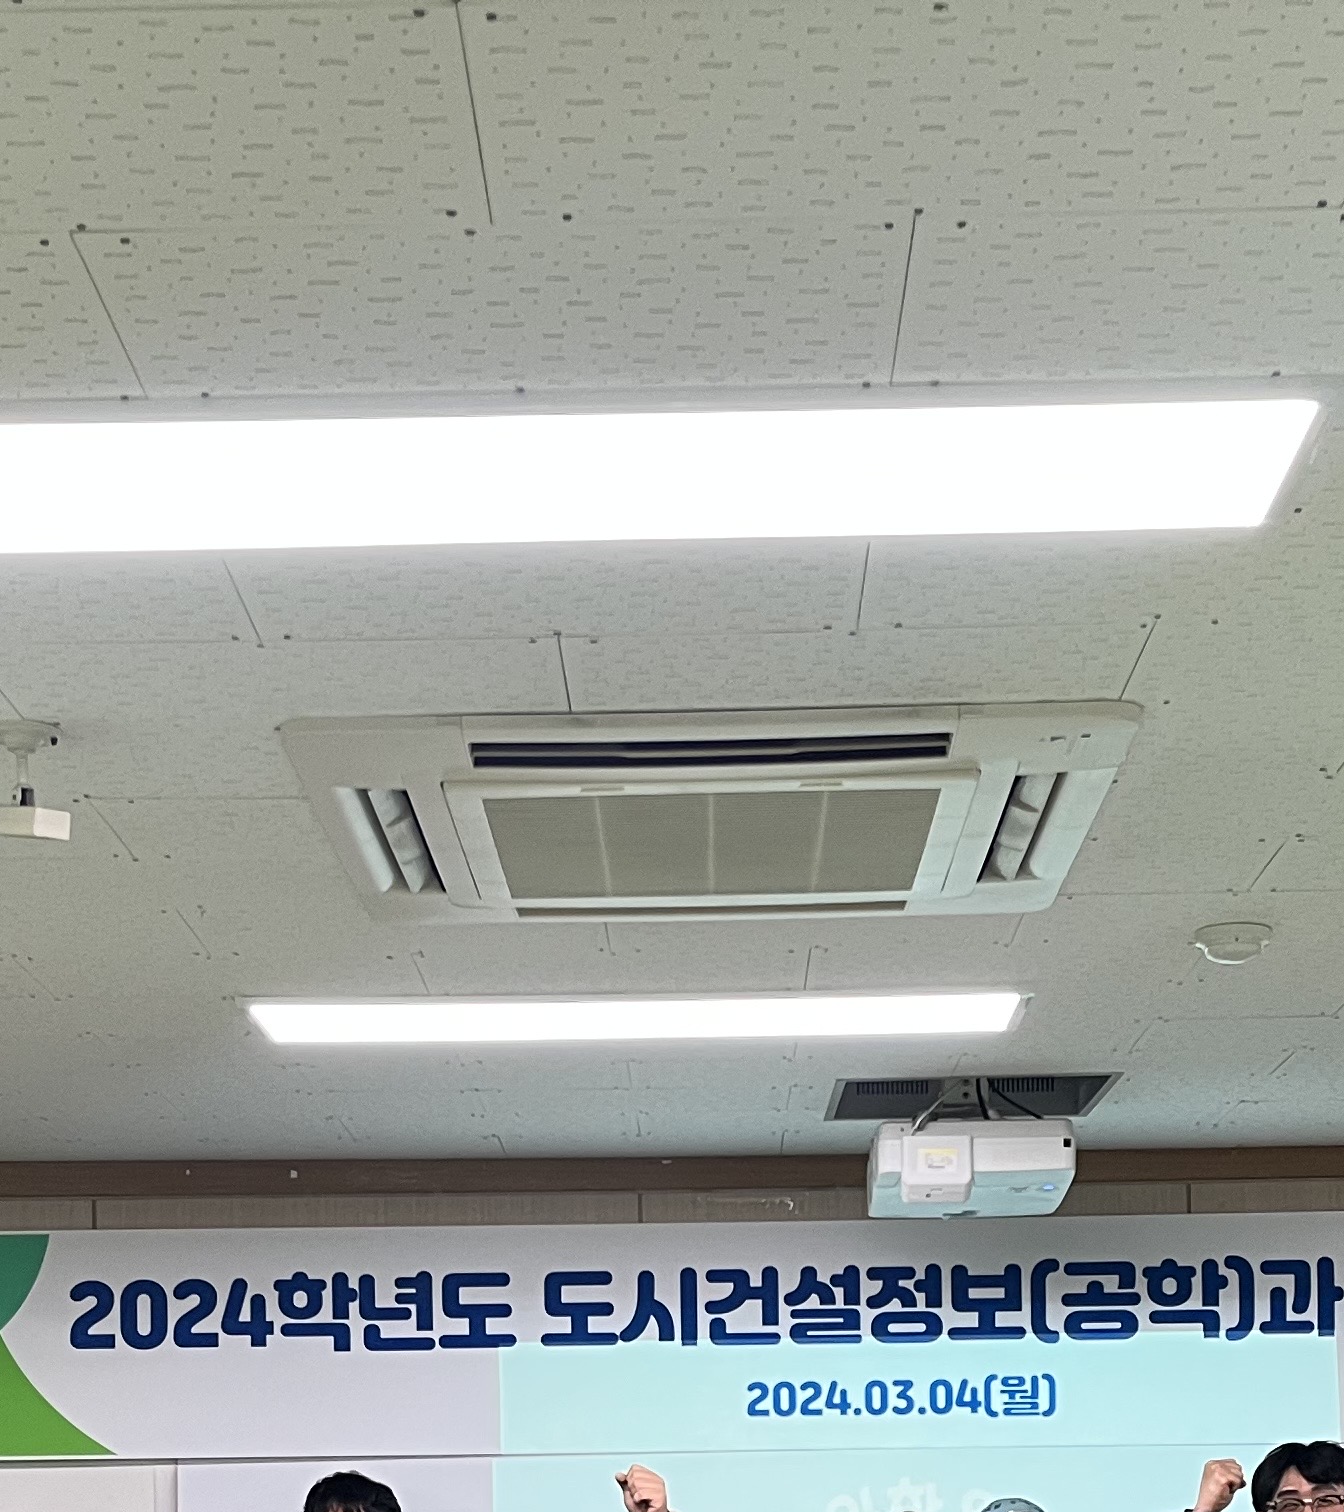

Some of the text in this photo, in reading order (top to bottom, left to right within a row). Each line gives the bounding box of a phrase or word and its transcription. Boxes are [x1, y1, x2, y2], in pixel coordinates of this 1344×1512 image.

[69, 1271, 518, 1353] 2024학년도
[540, 1256, 1343, 1348] 도시건설정보(공학)과
[746, 1372, 1057, 1418] 2024.03.04(월)
